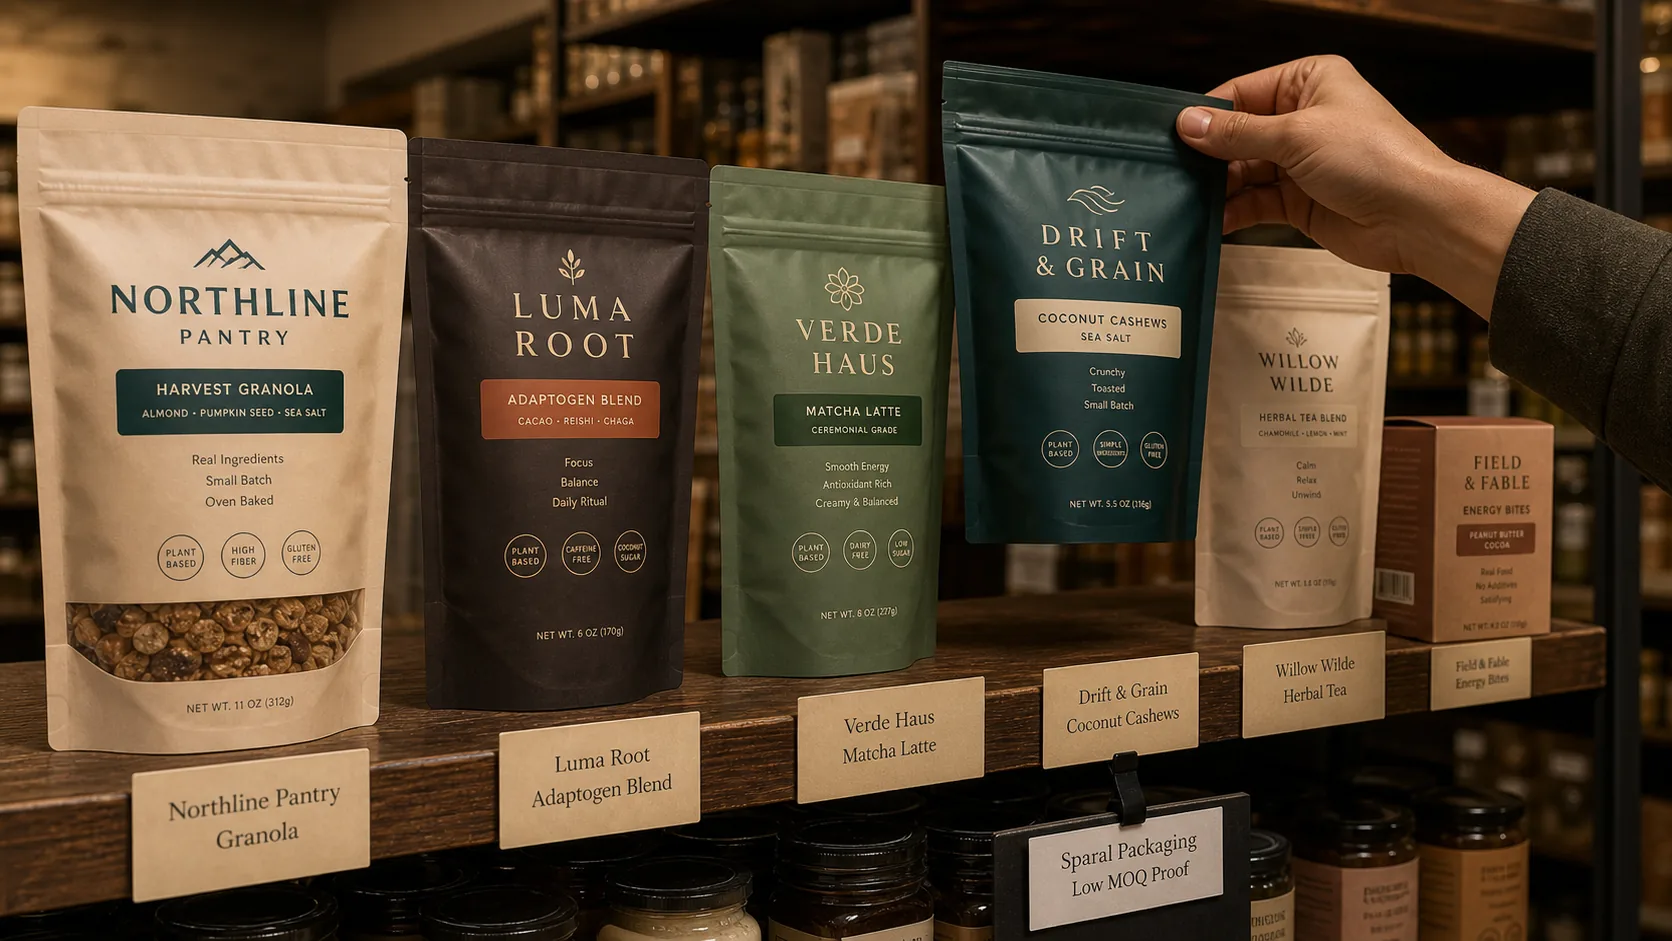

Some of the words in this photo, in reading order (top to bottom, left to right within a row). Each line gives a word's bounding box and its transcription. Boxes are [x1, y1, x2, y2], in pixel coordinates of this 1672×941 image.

[1041, 224, 1152, 252] DRIFT
[1036, 255, 1055, 276] &
[1066, 256, 1164, 283] GRAIN
[111, 284, 349, 318] NORTHLINE
[513, 292, 631, 322] LUMA
[1038, 313, 1104, 325] COCONUT
[1110, 315, 1167, 329] CASHEWS
[180, 328, 288, 345] PANTRY
[796, 319, 902, 345] VERDE
[1081, 332, 1101, 342] SEA
[1106, 333, 1131, 343] SALT
[515, 330, 634, 359] ROOT
[813, 352, 894, 376] HAUS
[1259, 352, 1339, 369] WILLOW
[1089, 367, 1126, 379] Crunchy
[157, 383, 231, 396] HARVEST
[238, 383, 314, 396] GRANOLA
[1092, 383, 1125, 393] Toasted
[1270, 376, 1334, 392] WILDE
[508, 394, 595, 406] ADAPTOGEN
[601, 394, 642, 406] BLEND
[1084, 400, 1108, 410] Small
[1111, 400, 1134, 410] Batch
[142, 408, 189, 418] ALMOND
[200, 408, 246, 418] PUMPKIN
[249, 408, 274, 417] SEED
[284, 408, 302, 417] SEA
[305, 408, 327, 417] SALT
[806, 406, 861, 417] MATCHA
[866, 406, 901, 417] LATTE
[1259, 413, 1296, 422] HERBAL
[1300, 413, 1317, 422] TEA
[1320, 413, 1347, 422] BLEND
[518, 417, 553, 425] CACAO
[563, 417, 594, 425] REISHI
[603, 417, 634, 425] CHAGA
[811, 426, 868, 434] CEREMONIAL
[871, 426, 898, 434] GRADE
[192, 454, 217, 465] Real
[220, 453, 284, 467] Ingredients
[564, 457, 594, 468] Focus
[1296, 461, 1316, 470] Calm
[1474, 455, 1521, 470] FIELD
[825, 462, 859, 472] Smooth
[861, 461, 889, 473] Energy
[206, 475, 237, 486] Small
[241, 474, 272, 485] Batch
[561, 477, 599, 488] Balance
[823, 480, 872, 490] Antioxidant
[874, 479, 892, 488] Rich
[1296, 476, 1317, 484] Relax
[1464, 476, 1475, 490] &
[1481, 475, 1530, 490] FABLE
[205, 496, 236, 507] Oven
[240, 495, 274, 506] Baked
[1292, 491, 1321, 499] Unwind
[552, 497, 578, 510] Daily
[580, 496, 608, 507] Ritual
[815, 498, 851, 509] Creamy
[853, 498, 860, 507] &
[862, 496, 898, 506] Balanced
[1070, 500, 1086, 508] NET
[1088, 500, 1104, 508] WT.
[1106, 500, 1118, 508] 5.5
[1119, 500, 1130, 508] OZ
[1463, 505, 1502, 515] ENERGY
[1505, 505, 1530, 515] BITES
[1469, 531, 1498, 539] PEANUT
[231, 546, 255, 555] HIGH
[287, 544, 316, 553] GLUTEN
[511, 547, 539, 555] PLANT
[565, 545, 597, 553] CAFFEINE
[850, 541, 871, 549] DAIRY
[1484, 541, 1510, 549] COCOA
[166, 548, 196, 557] PLANT
[292, 554, 311, 563] FREE
[620, 554, 641, 562] SUGAR
[799, 554, 824, 562] BASED
[852, 551, 869, 559] FREE
[166, 559, 197, 568] BASED
[231, 557, 257, 566] FIBER
[511, 557, 540, 566] BASED
[572, 555, 591, 563] FREE
[821, 611, 837, 620] NET
[840, 610, 855, 618] WT.
[857, 609, 862, 617] 8
[864, 608, 875, 617] OZ
[536, 631, 555, 640] NET
[558, 630, 575, 639] WT.
[577, 629, 583, 638] 6
[585, 628, 598, 637] OZ
[600, 626, 624, 638] (170g)
[1276, 661, 1318, 678] Willow
[1321, 656, 1355, 672] Wilde
[1456, 659, 1477, 672] Field
[1488, 656, 1510, 668] Fable
[1456, 678, 1485, 690] Energy
[1079, 686, 1112, 705] Drift
[1116, 685, 1127, 700] &
[1131, 681, 1168, 698] Grain
[1284, 685, 1323, 704] Herbal
[1326, 683, 1347, 698] Tea
[187, 703, 208, 713] NET
[211, 701, 231, 712] WT.
[234, 700, 244, 710] 11
[247, 699, 262, 709] OZ
[264, 696, 294, 709] (312g)
[844, 714, 890, 734] Verde
[896, 711, 935, 728] Haus
[1067, 715, 1122, 734] Coconut
[1125, 708, 1180, 726] Cashews
[843, 743, 896, 764] Matcha
[901, 740, 937, 756] Latte
[555, 755, 605, 773] Luma
[610, 748, 650, 766] Root
[532, 784, 621, 809] Adaptogen
[627, 773, 672, 795] Blend
[168, 794, 269, 822] Northline
[276, 787, 341, 808] Pantry
[216, 821, 299, 849] Granola
[1061, 844, 1112, 873] Sparal
[1118, 834, 1197, 859] Packaging
[1072, 880, 1103, 897] Low
[1108, 869, 1147, 890] MOQ
[1152, 860, 1190, 882] Proof
